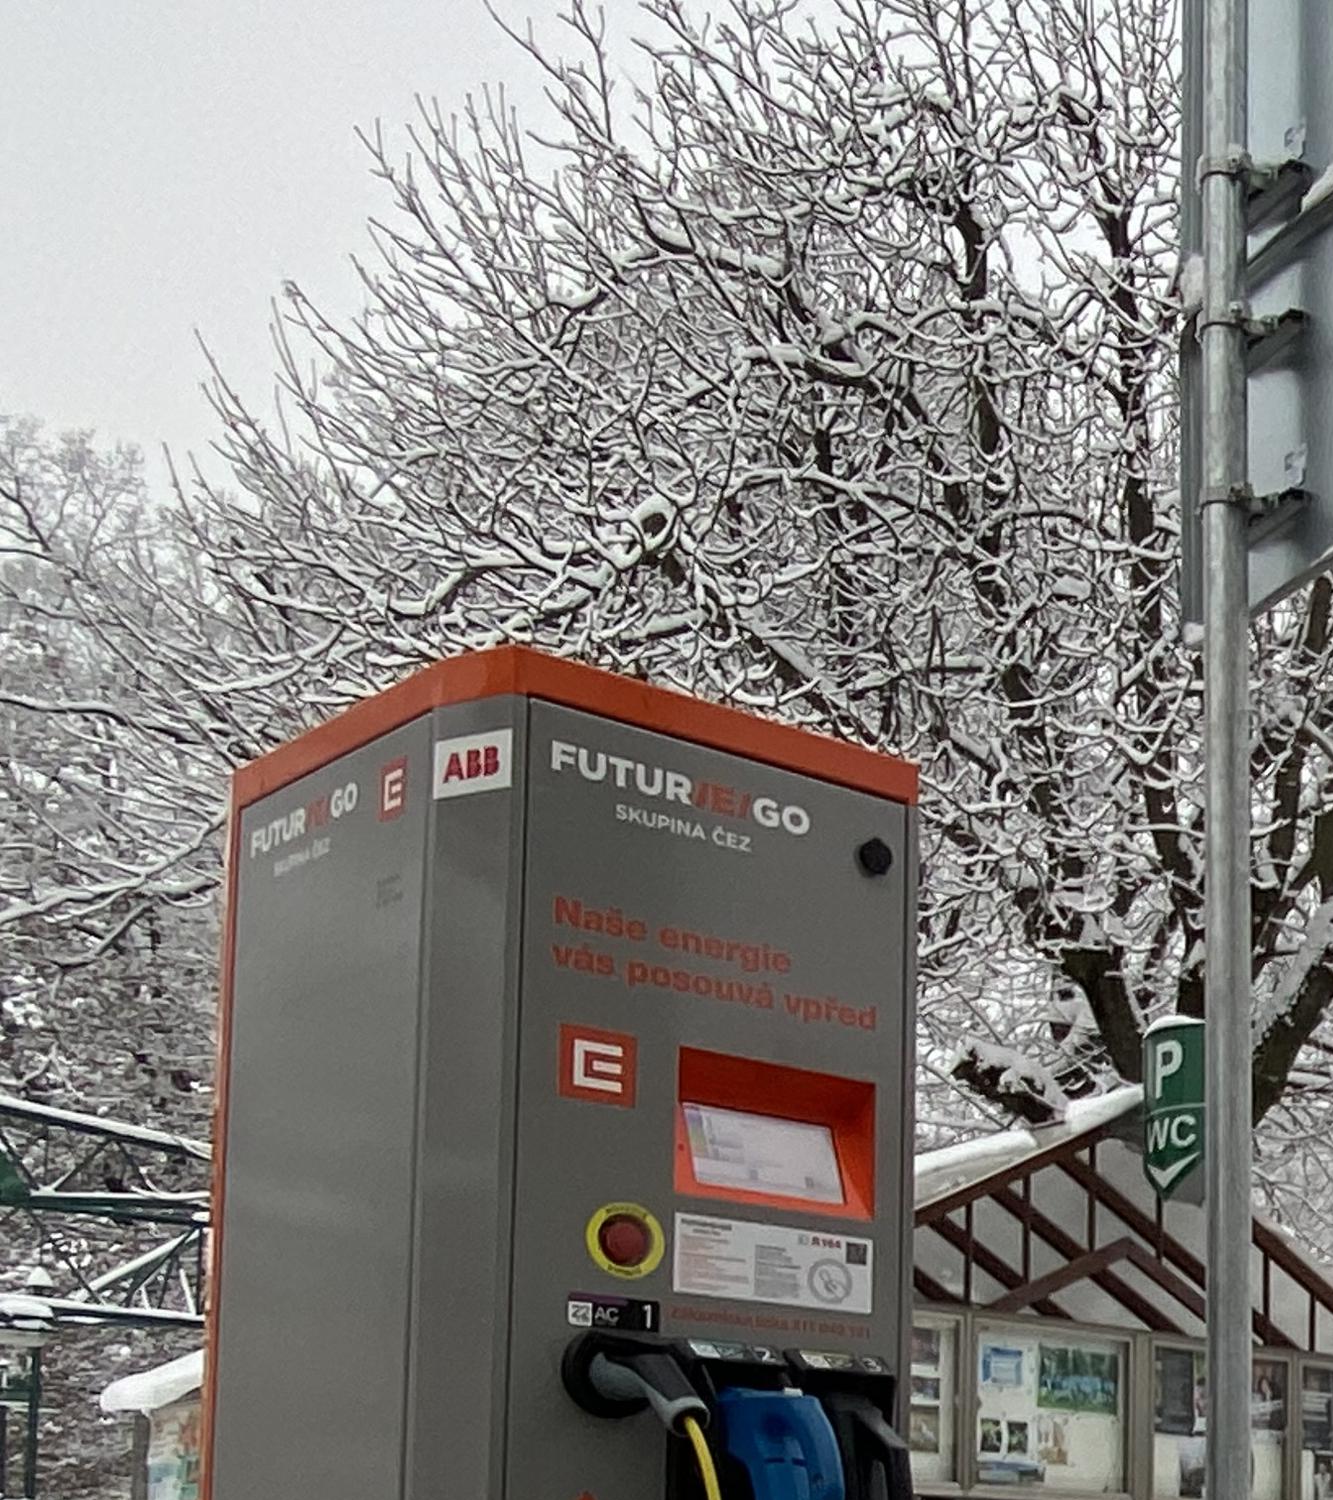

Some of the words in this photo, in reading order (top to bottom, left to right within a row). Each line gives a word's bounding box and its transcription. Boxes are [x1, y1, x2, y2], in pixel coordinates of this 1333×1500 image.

[443, 745, 500, 783] ABB
[615, 803, 706, 841] SKUPINA
[711, 826, 751, 852] ČEZ
[554, 896, 647, 941] Naše
[659, 926, 792, 975] energie
[552, 943, 616, 976] vás
[626, 959, 774, 1010] posouvá
[785, 993, 877, 1031] vpřed
[1155, 1039, 1183, 1099] P
[1147, 1114, 1197, 1153] WC
[642, 1304, 652, 1329] 1
